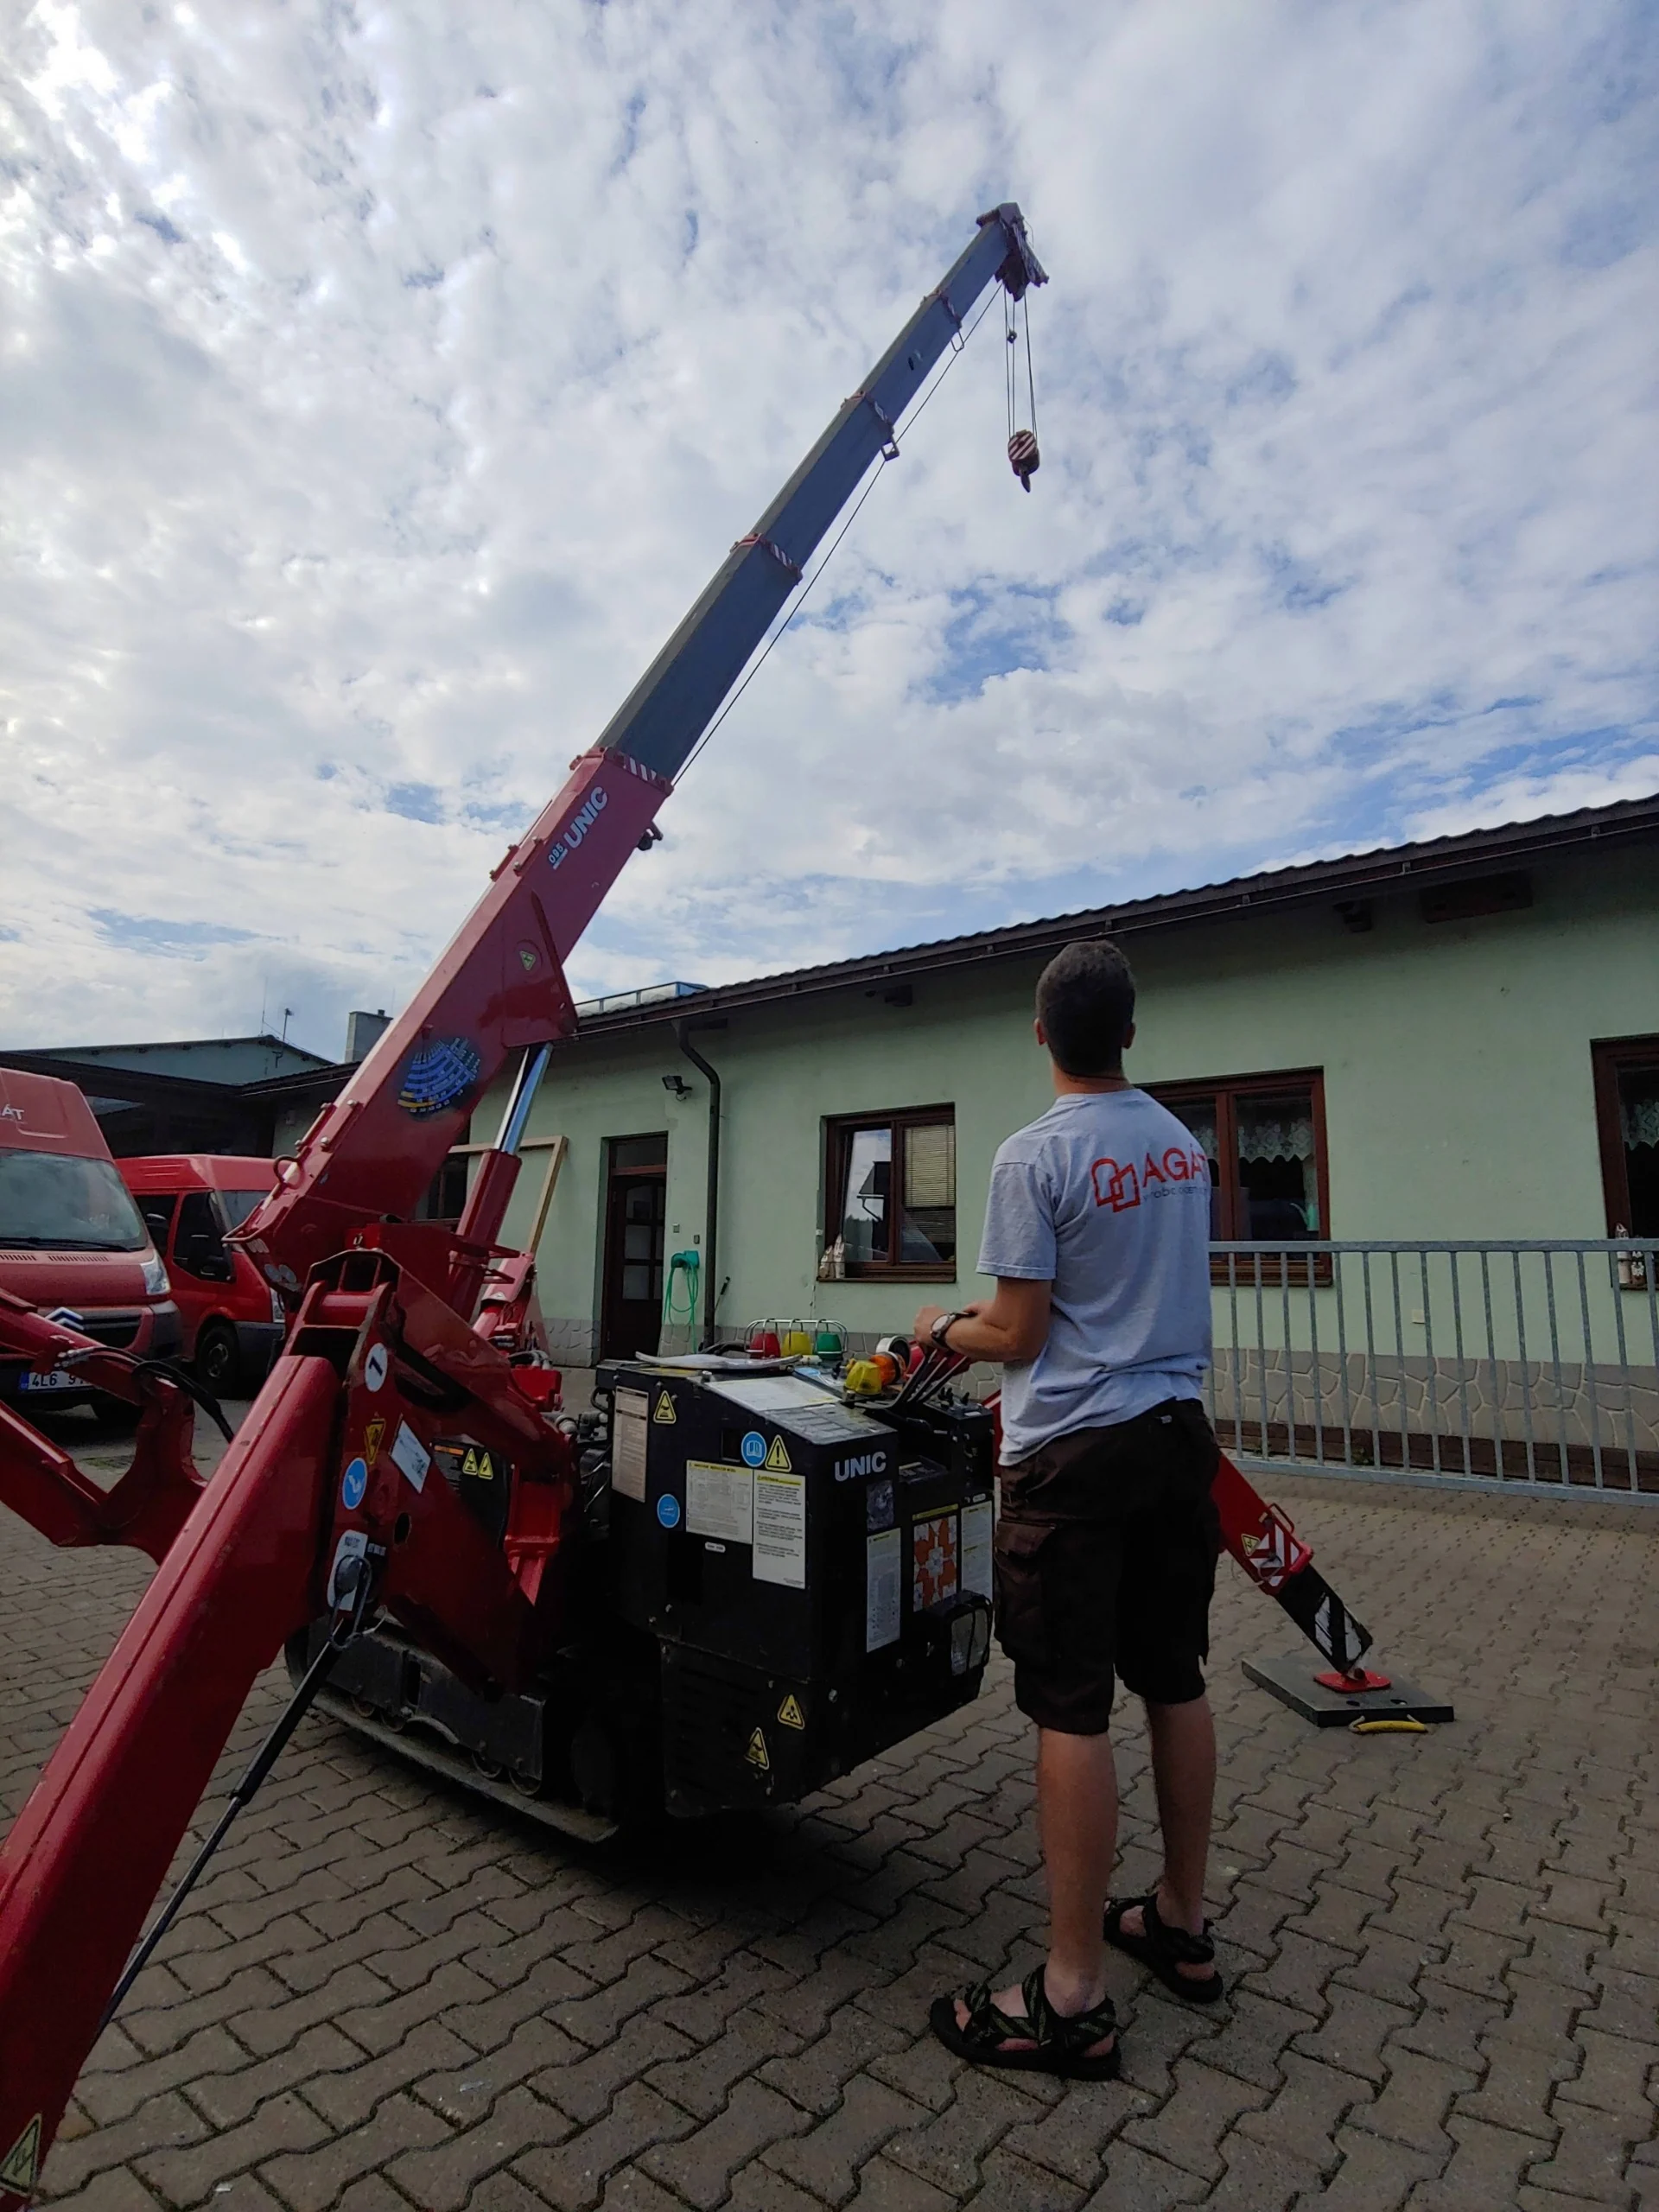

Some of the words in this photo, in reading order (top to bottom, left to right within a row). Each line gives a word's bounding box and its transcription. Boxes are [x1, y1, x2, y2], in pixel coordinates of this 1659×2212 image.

[563, 786, 608, 849] UNIC
[0, 1103, 25, 1121] ÁT
[31, 1372, 58, 1387] 4L6
[834, 1451, 887, 1482] UNIC
